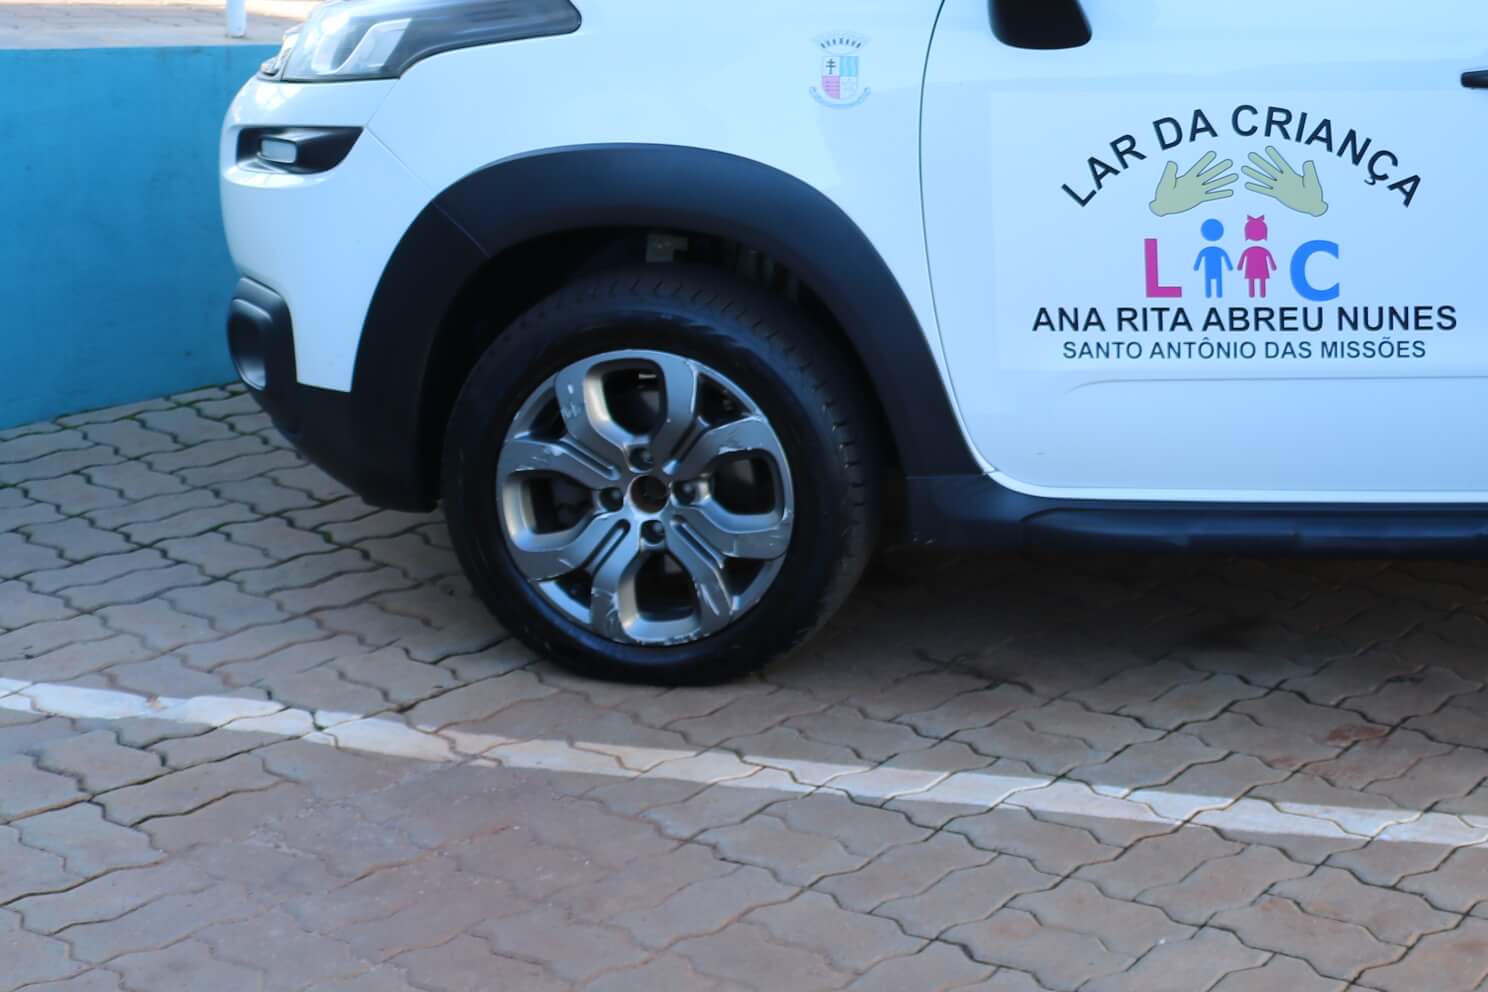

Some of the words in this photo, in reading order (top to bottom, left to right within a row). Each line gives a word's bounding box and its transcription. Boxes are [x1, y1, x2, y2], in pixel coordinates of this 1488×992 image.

[1061, 133, 1147, 208] LAR
[1152, 108, 1219, 151] DA
[1231, 104, 1422, 209] CRIANÇA
[1031, 306, 1107, 332] ANA
[1116, 306, 1194, 332] RITA
[1201, 306, 1325, 332] ABREU
[1337, 305, 1458, 332] NUNES
[1062, 340, 1143, 360] SANTO
[1149, 336, 1257, 360] ANTÔNIO
[1263, 340, 1313, 360] DAS
[1320, 336, 1427, 360] MISSÕES
